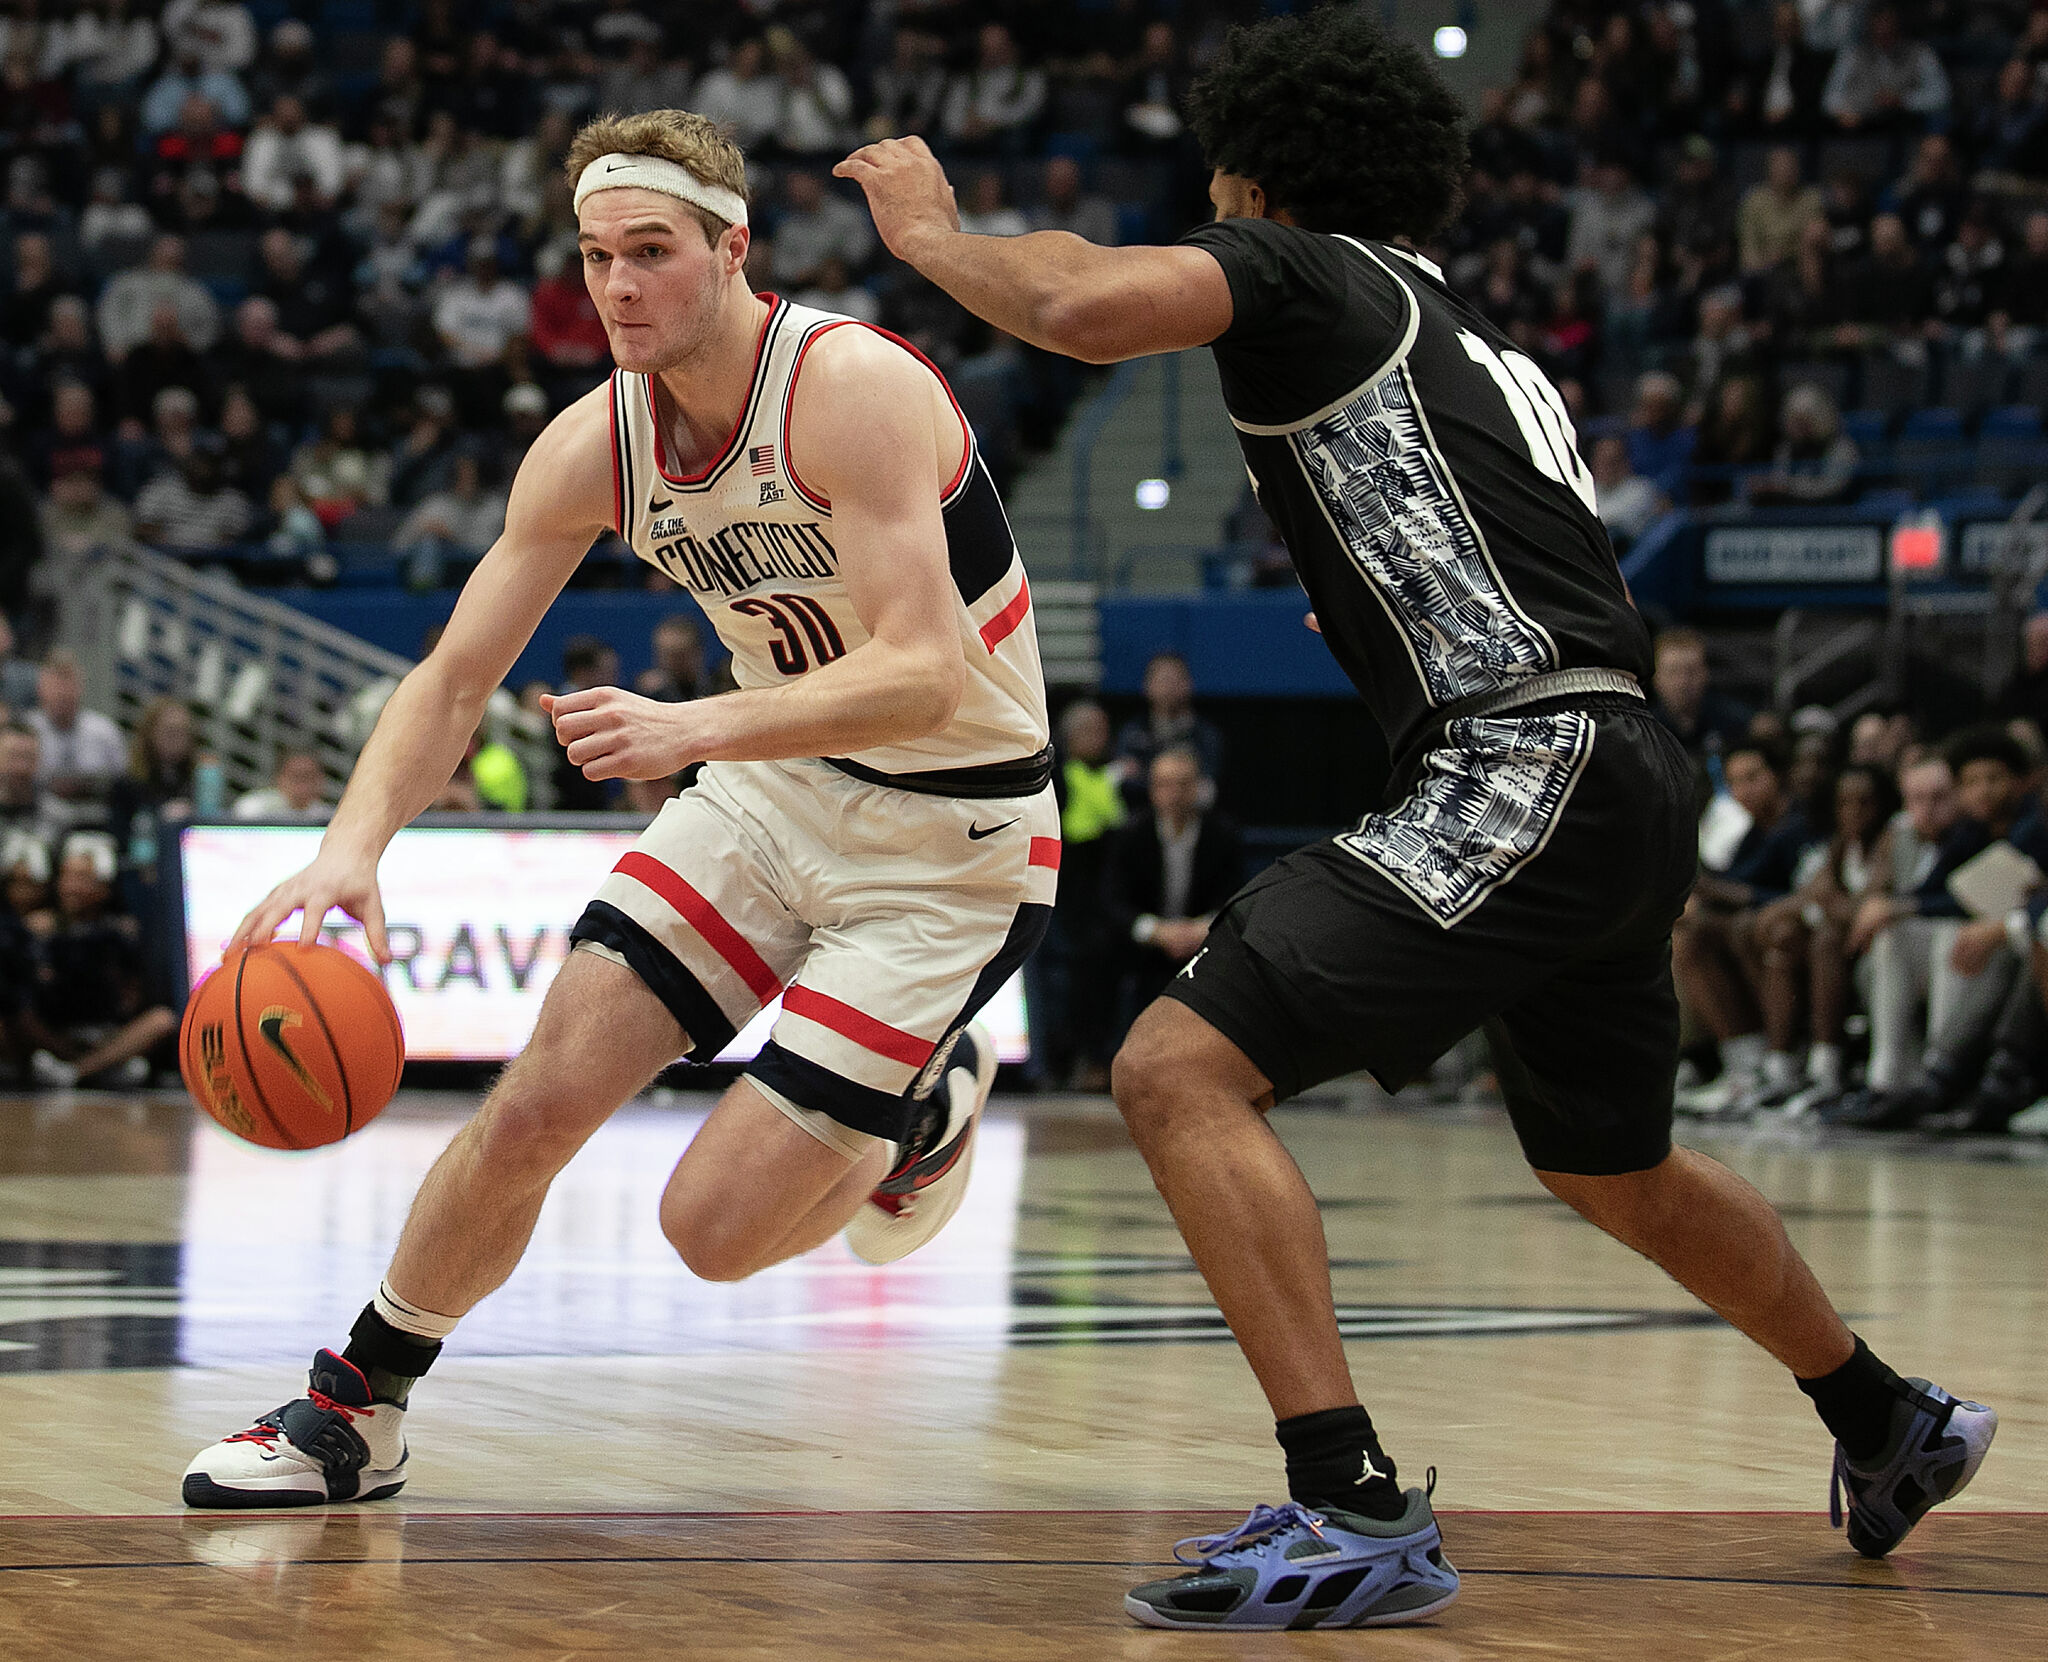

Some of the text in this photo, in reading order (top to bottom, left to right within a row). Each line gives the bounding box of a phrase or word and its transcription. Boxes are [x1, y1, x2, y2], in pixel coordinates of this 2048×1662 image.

[1455, 326, 1598, 518] 10
[760, 481, 776, 492] BIG
[760, 489, 785, 501] EAST
[653, 517, 684, 531] BE THE
[651, 527, 688, 540] CHANGE
[655, 521, 840, 596] CONECTICUT
[729, 593, 847, 676] 30
